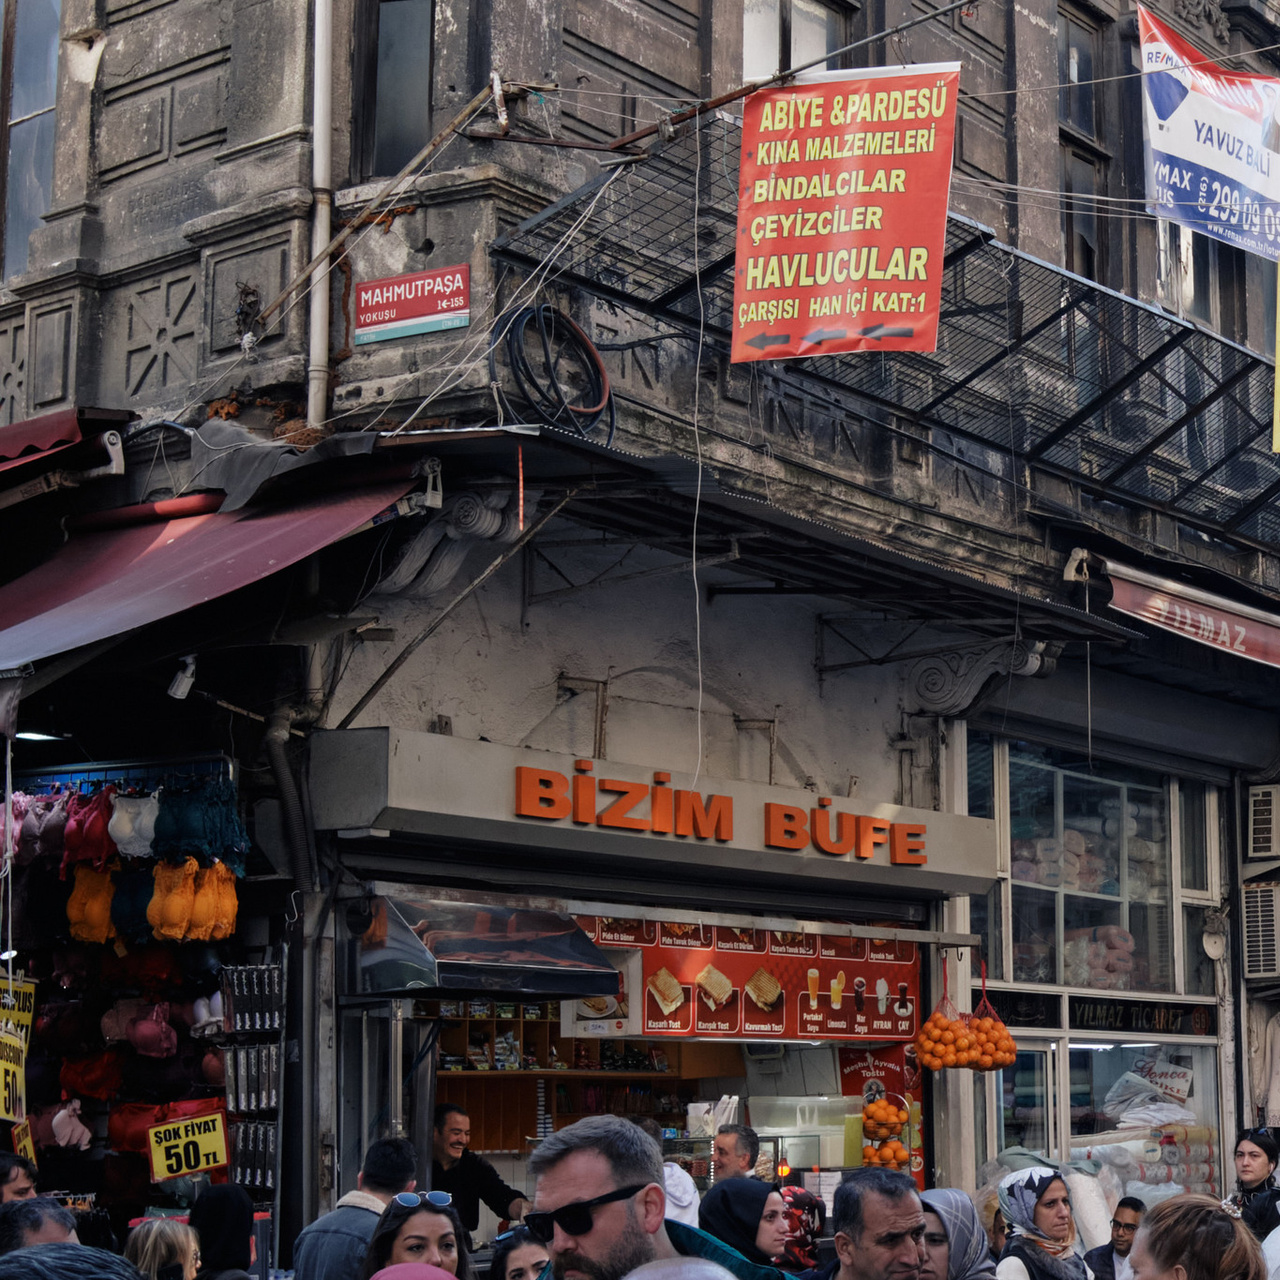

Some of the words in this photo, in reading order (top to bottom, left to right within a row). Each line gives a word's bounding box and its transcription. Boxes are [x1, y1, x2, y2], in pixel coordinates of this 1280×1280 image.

[759, 93, 824, 132] ABİYE
[756, 139, 800, 165] KINA
[805, 123, 936, 161] MALZEMELERİ
[1194, 119, 1244, 161] YAVUZ
[1246, 145, 1271, 178] BALİ
[753, 168, 906, 204] BİNDALCILAR
[750, 206, 884, 246] ÇEYİZCİLER
[1209, 182, 1240, 225] 299
[1243, 196, 1261, 235] 09
[1206, 222, 1280, 258] www.remax.com.tr/lotu
[745, 247, 929, 291] HAVLUCULAR
[361, 273, 464, 308] MAHMUTPAŞA
[738, 297, 800, 329] ÇARŞISI
[808, 293, 839, 318] HAN
[846, 286, 867, 317] İÇİ
[871, 291, 926, 314] KAT:1
[360, 308, 397, 324] YOKUŞU
[1156, 598, 1247, 653] YILMAZ
[514, 758, 735, 842] BİZİM
[1074, 1002, 1125, 1028] YILMAZ
[1130, 1003, 1185, 1031] TİCARET
[861, 1070, 885, 1078] Tostu
[154, 1126, 182, 1147] ŞOK
[183, 1118, 218, 1139] FİYAT
[164, 1140, 201, 1175] 50
[203, 1150, 220, 1166] TL
